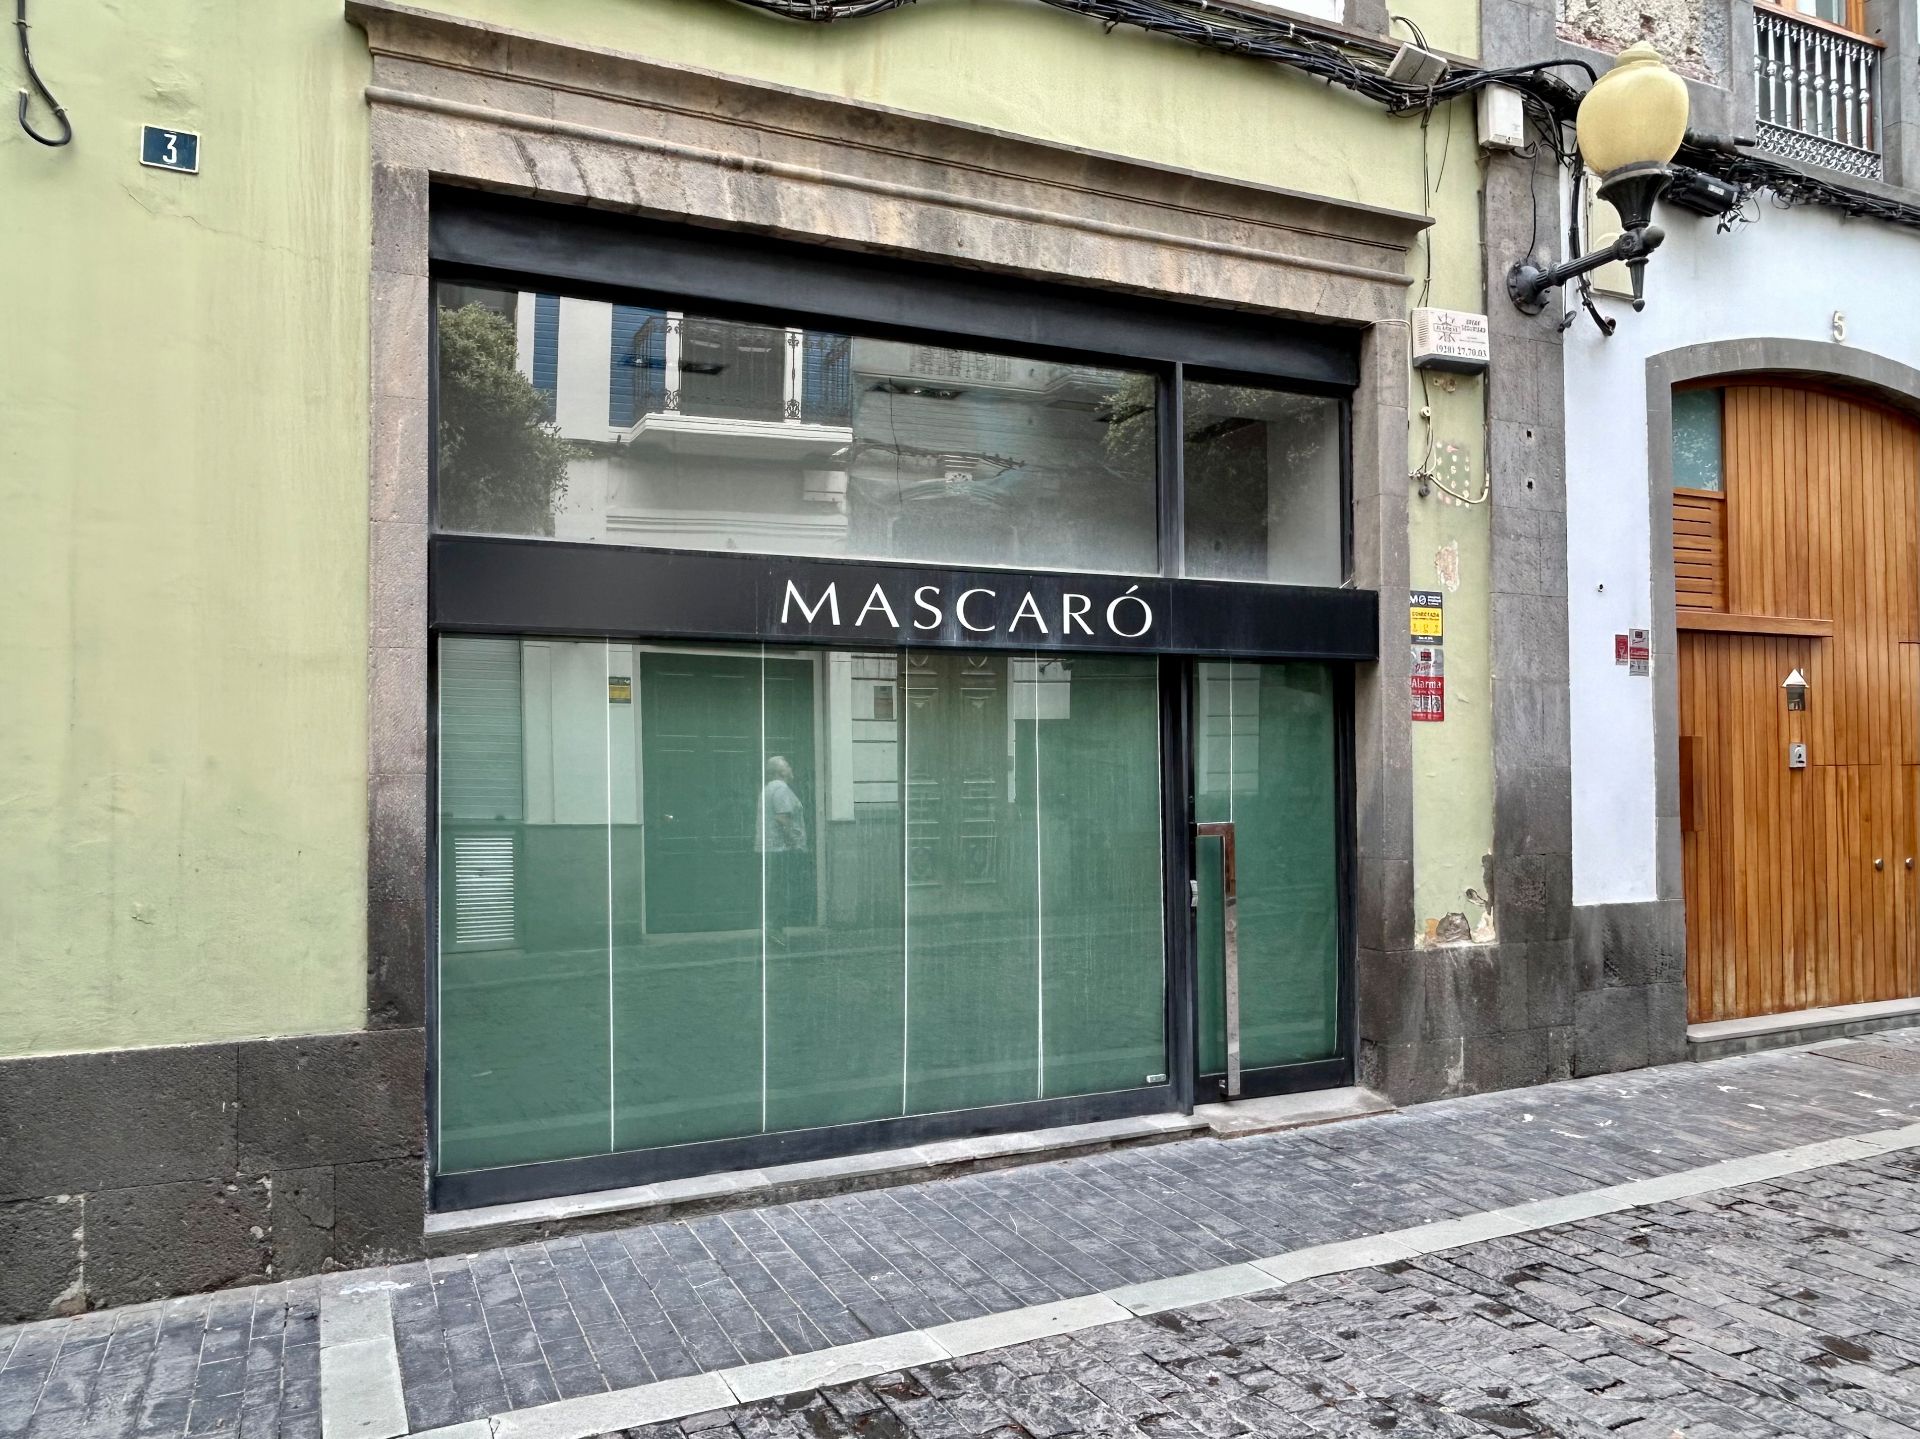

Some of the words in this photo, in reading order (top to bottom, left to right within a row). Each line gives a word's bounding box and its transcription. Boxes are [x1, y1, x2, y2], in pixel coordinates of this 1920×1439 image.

[162, 133, 177, 164] 3
[1832, 310, 1846, 341] 5
[780, 579, 1153, 638] MASCARÓ
[1411, 678, 1442, 689] Alarma
